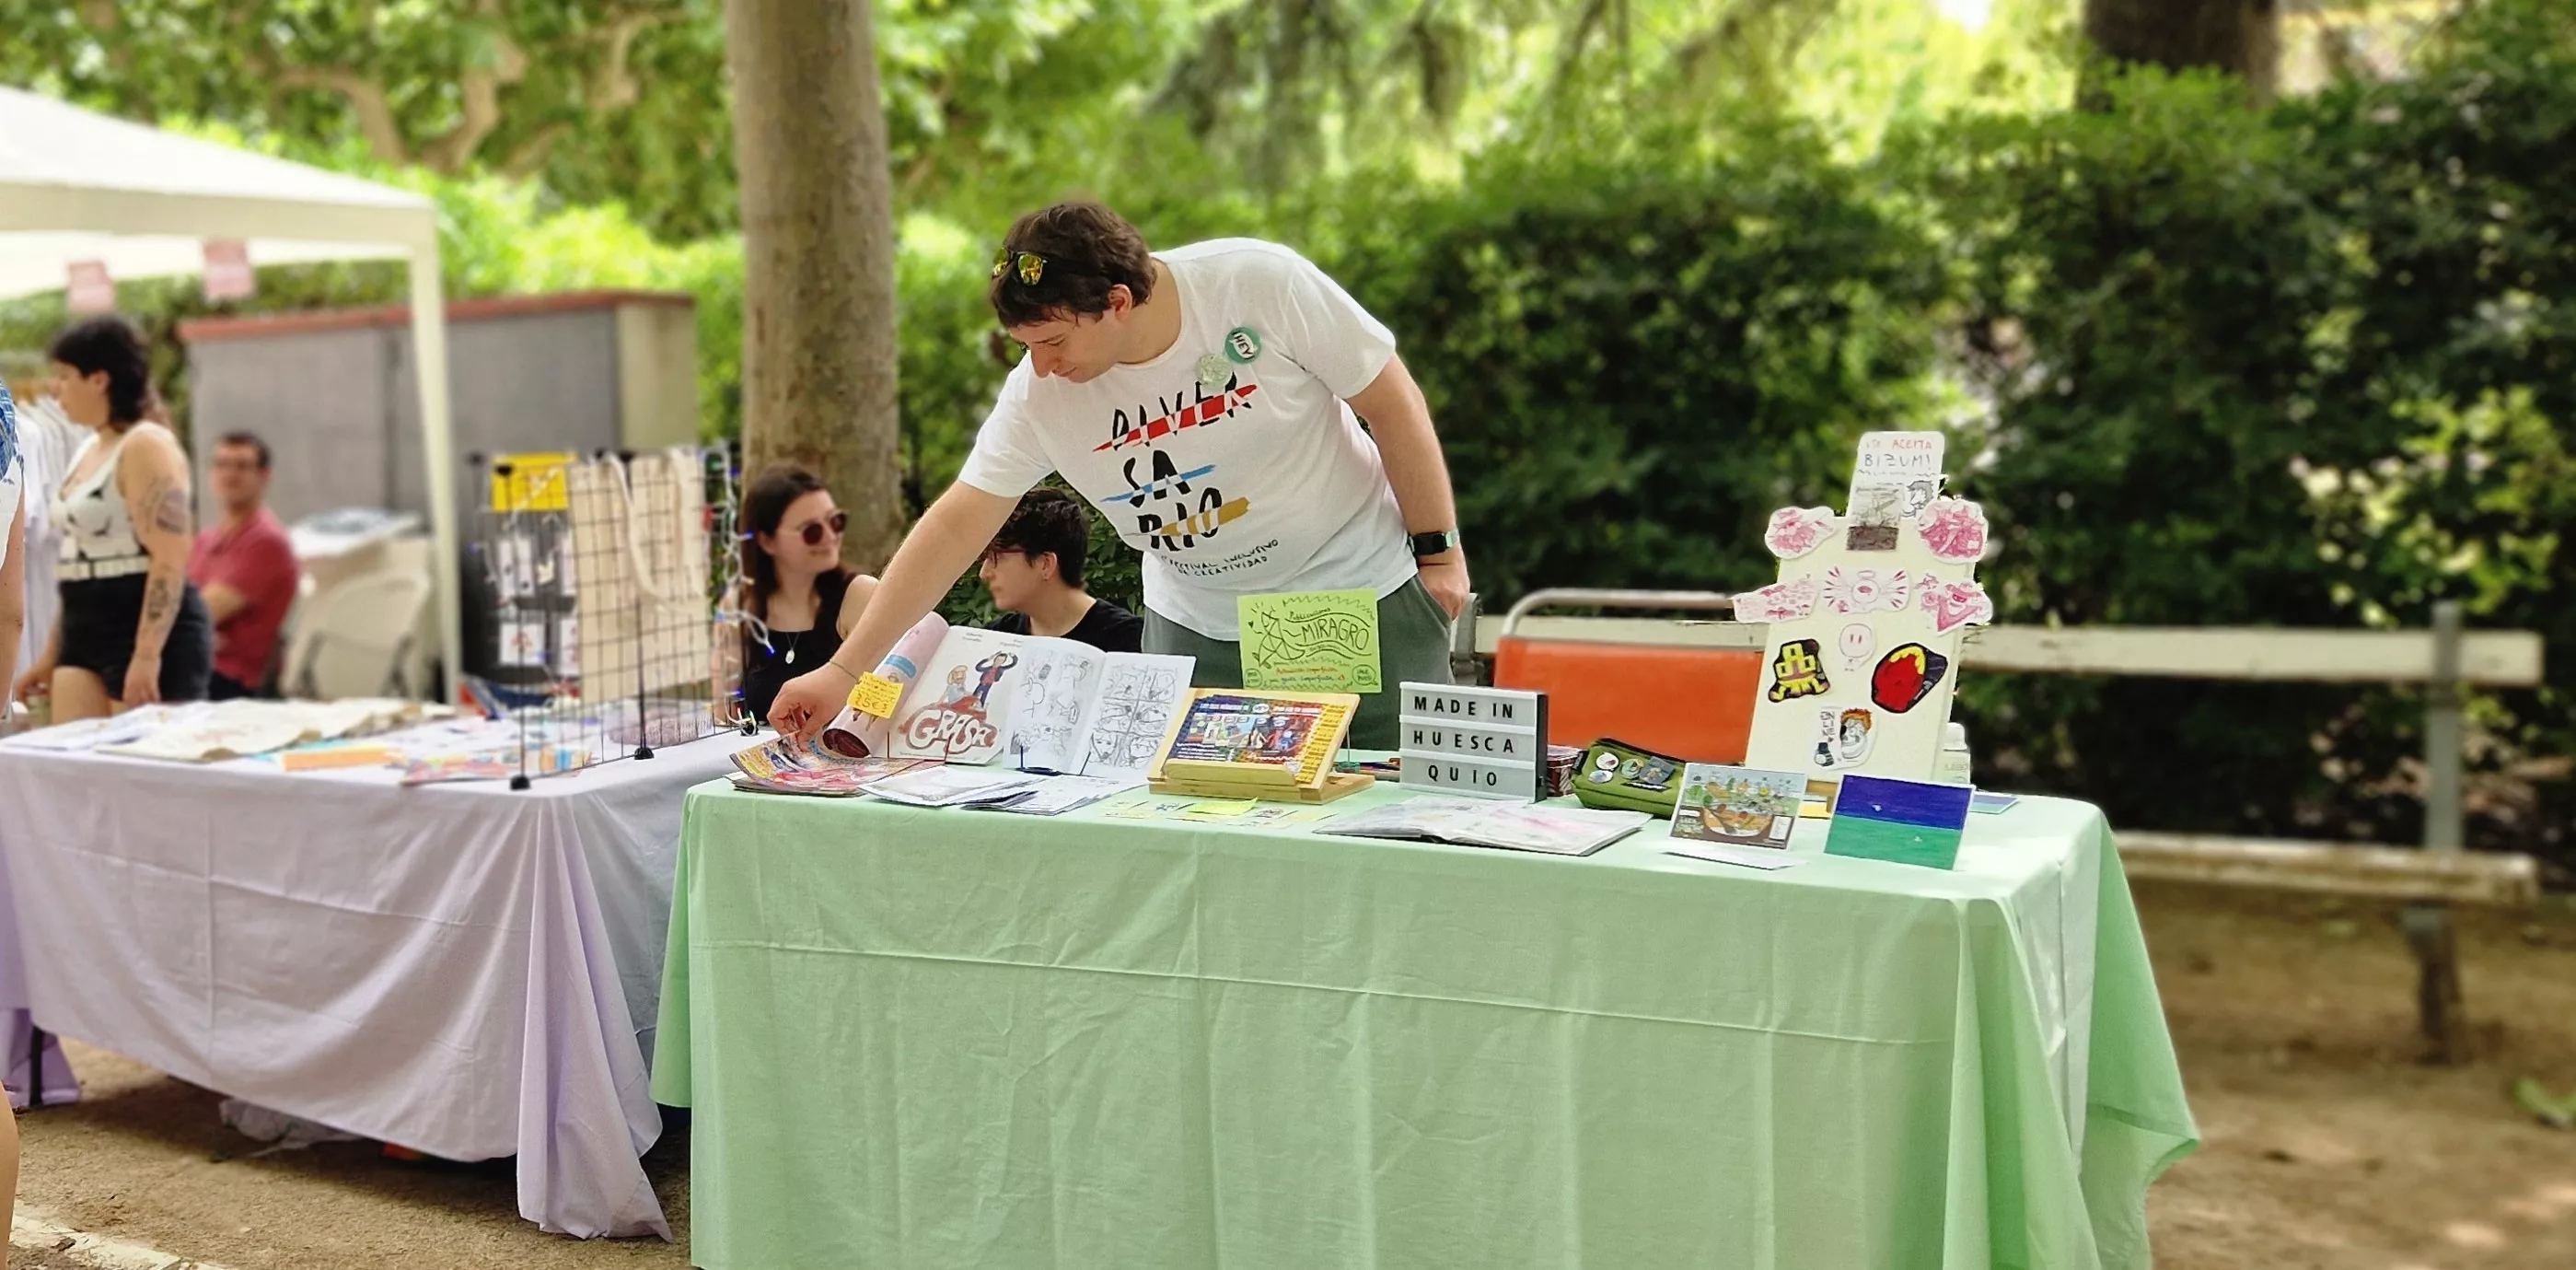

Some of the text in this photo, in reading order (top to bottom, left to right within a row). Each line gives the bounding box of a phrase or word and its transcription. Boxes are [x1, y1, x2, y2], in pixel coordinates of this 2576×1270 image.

[1123, 449, 1192, 508] SA
[1136, 487, 1223, 552] RIO
[1194, 556, 1268, 577] CREATIVIDAD
[1301, 618, 1369, 650] MIRAGRO
[1414, 696, 1513, 718] MADE IN
[1413, 730, 1514, 753] HUESCA
[1428, 764, 1497, 786] QUIO
